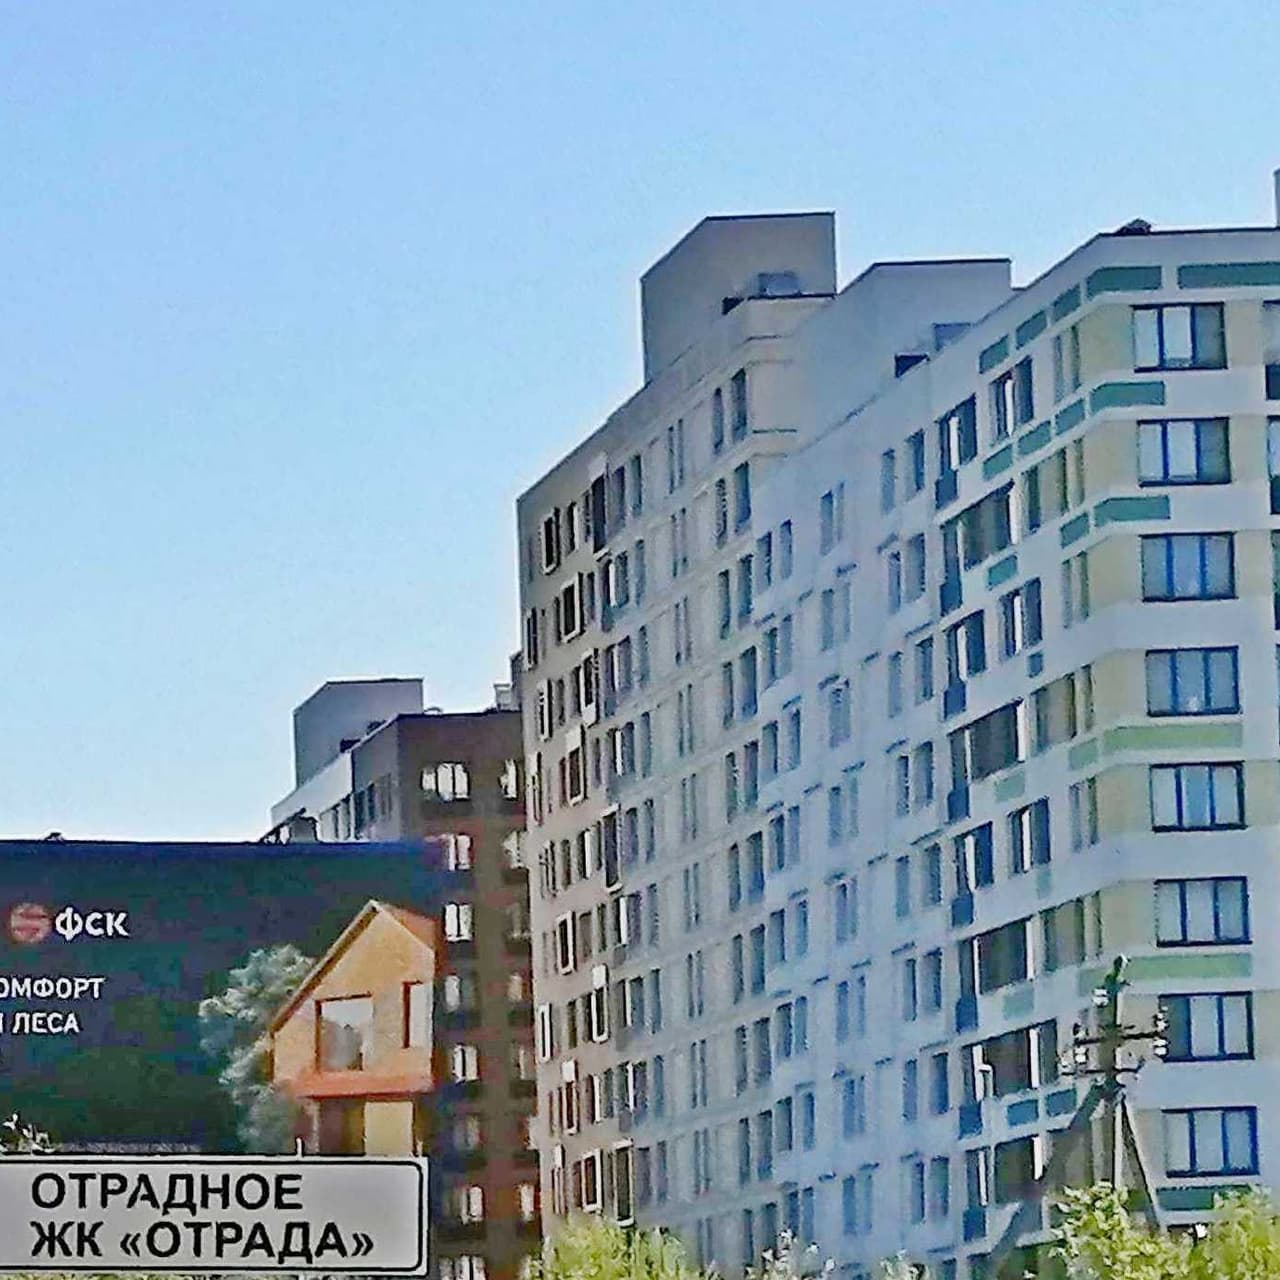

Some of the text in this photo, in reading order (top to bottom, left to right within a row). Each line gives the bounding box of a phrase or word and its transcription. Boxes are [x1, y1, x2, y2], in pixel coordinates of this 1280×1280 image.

[55, 906, 130, 941] ФСК
[11, 1011, 81, 1034] ЛЕСА
[30, 1172, 304, 1216] ОТРАДНОЕ
[29, 1220, 375, 1265] ЖК «ОТРАДА»
